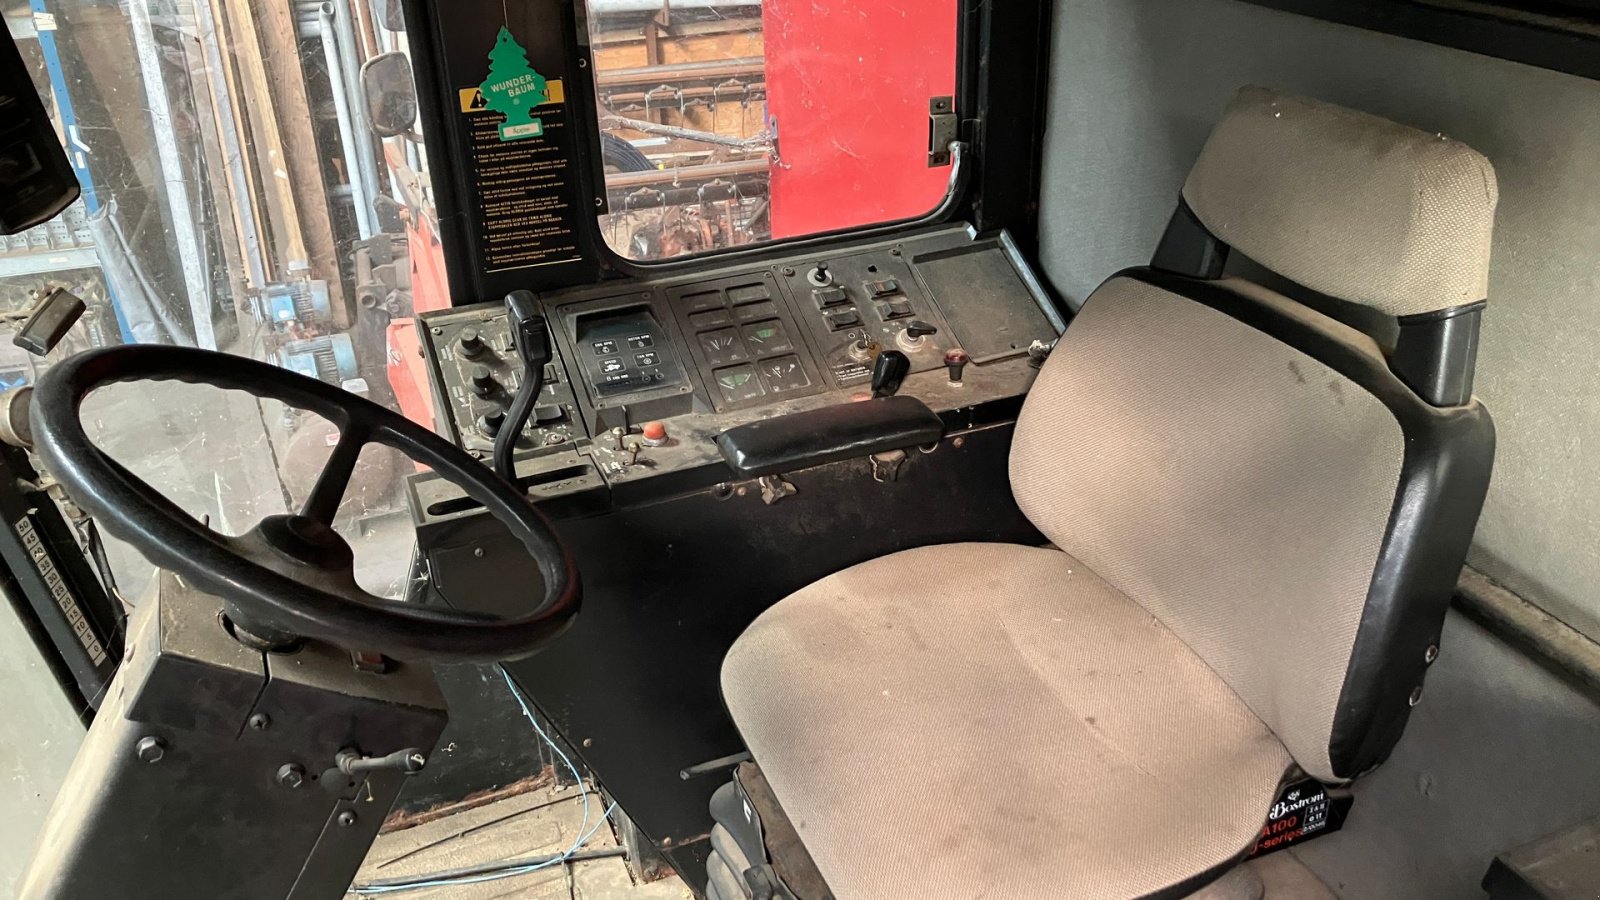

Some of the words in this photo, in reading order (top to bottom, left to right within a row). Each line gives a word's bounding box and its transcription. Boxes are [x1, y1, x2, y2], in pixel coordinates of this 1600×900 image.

[490, 74, 536, 93] WUNDER-
[507, 83, 536, 97] BAUM
[18, 520, 29, 532] 50
[26, 533, 36, 545] 45
[39, 560, 50, 572] 35
[47, 572, 57, 584] 30
[54, 586, 65, 597] 25
[61, 597, 72, 609] 20
[69, 609, 78, 620] 15
[76, 621, 85, 632] 10
[87, 633, 93, 641] 5
[93, 644, 99, 652] 0
[1269, 793, 1324, 820] Bostrom
[1261, 816, 1298, 838] A100
